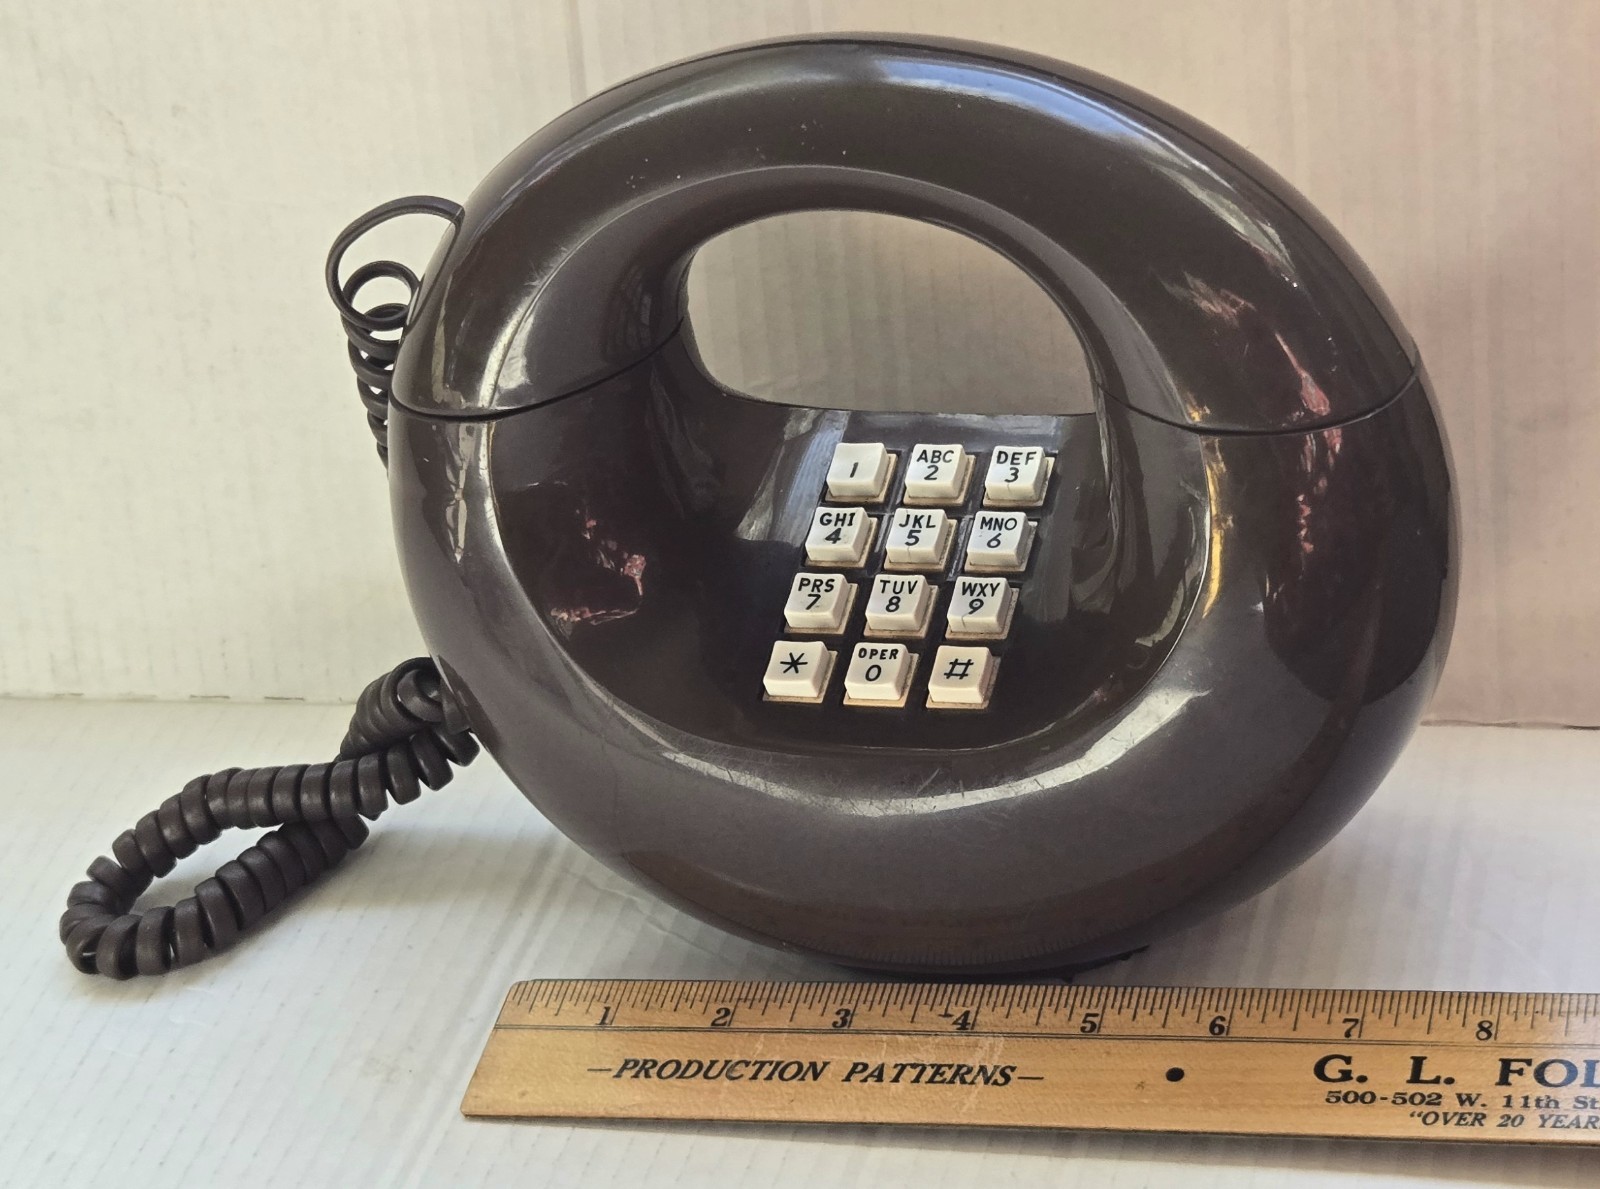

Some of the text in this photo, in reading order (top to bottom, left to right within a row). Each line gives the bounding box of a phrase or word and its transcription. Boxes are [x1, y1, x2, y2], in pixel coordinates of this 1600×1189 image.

[916, 449, 955, 464] ABC
[996, 450, 1037, 465] DEF
[849, 462, 859, 478] 1
[923, 465, 939, 481] 2
[1004, 467, 1020, 483] 3
[819, 512, 856, 527] GHI
[898, 514, 937, 528] JKL
[979, 517, 1018, 531] MNO
[824, 528, 842, 544] 4
[905, 530, 922, 546] 5
[986, 533, 1001, 549] 6
[797, 578, 836, 592] PRS
[879, 579, 918, 595] TUV
[961, 581, 1001, 597] WXY
[805, 593, 821, 610] 7
[885, 596, 901, 613] 8
[968, 598, 984, 615] 9
[858, 647, 899, 660] OPER
[595, 1006, 1494, 1041] 1 2 3 4 5 6 7 8
[1313, 1054, 1369, 1084] G.
[1406, 1056, 1456, 1086] L.
[1325, 1090, 1443, 1107] 500-502
[1455, 1093, 1487, 1108] W.
[1502, 1094, 1560, 1109] 11th
[1496, 1114, 1525, 1128] 20
[1538, 1114, 1600, 1130] YEAR
